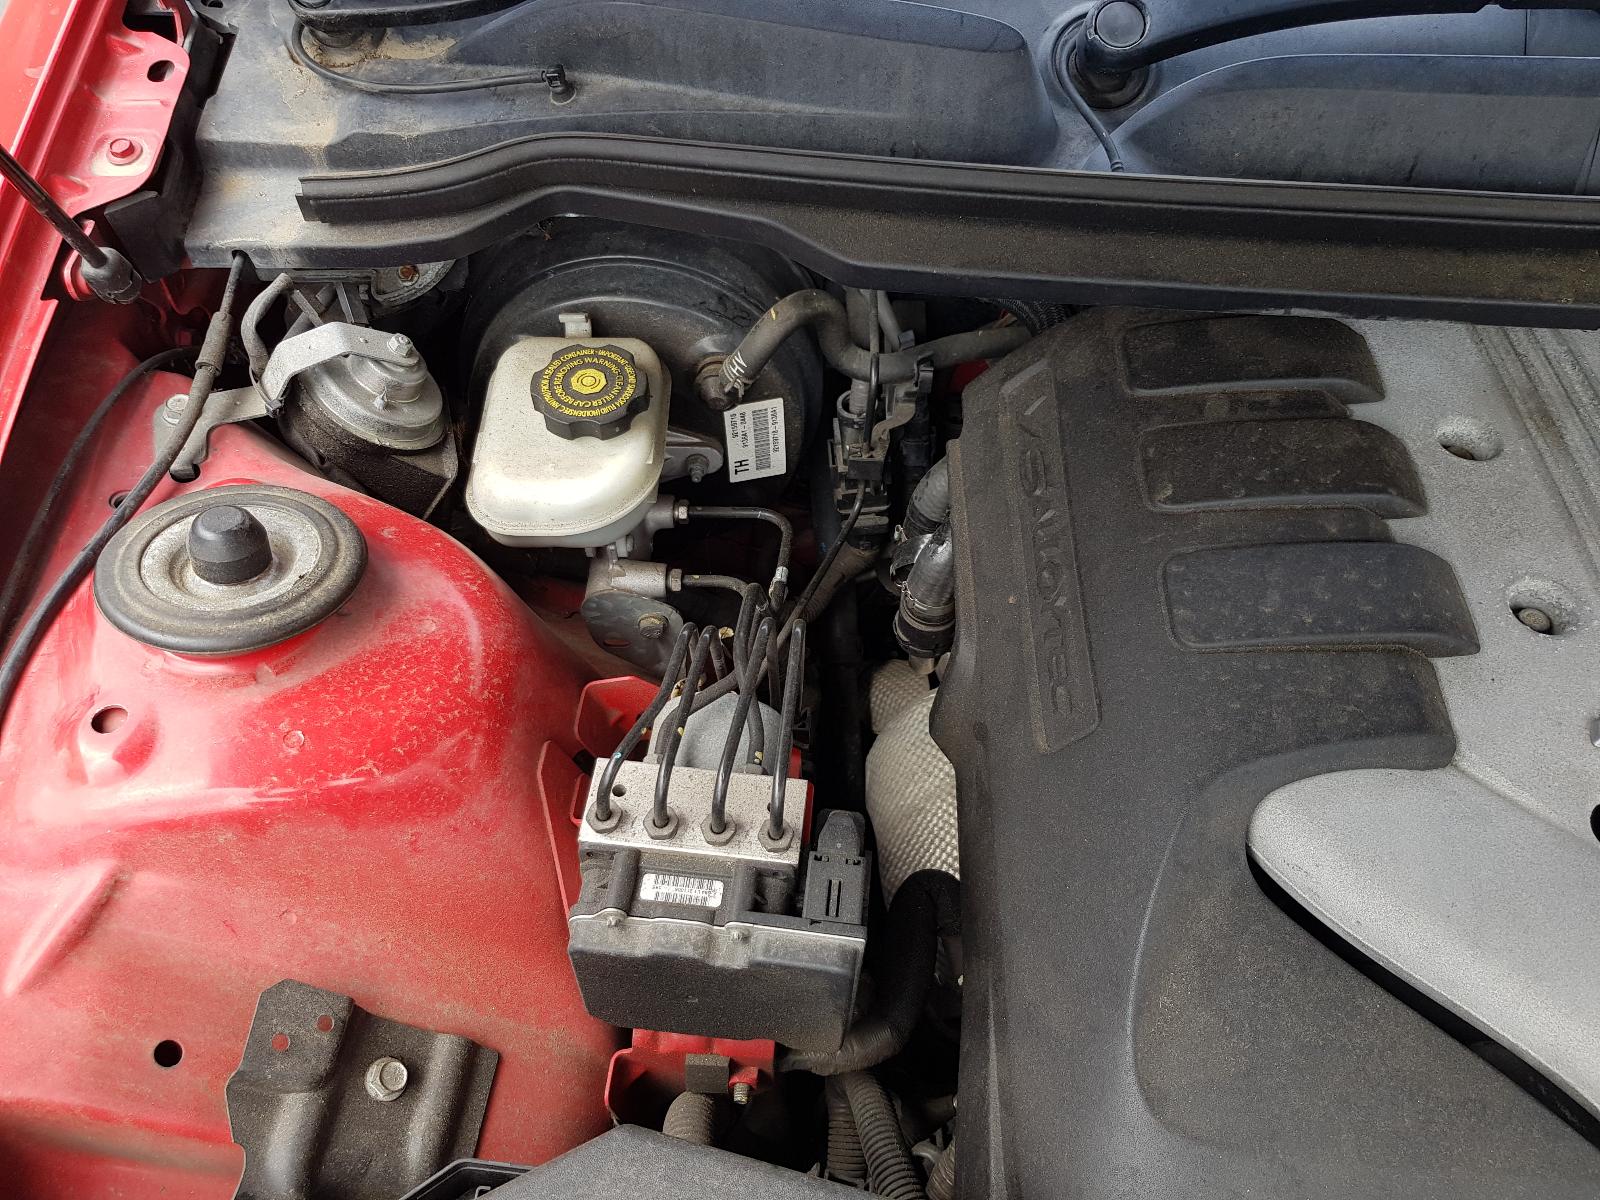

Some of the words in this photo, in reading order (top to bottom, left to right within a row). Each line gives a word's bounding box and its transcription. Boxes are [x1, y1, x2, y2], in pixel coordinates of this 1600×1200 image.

[560, 349, 595, 361] CONTAINER
[553, 359, 583, 385] REMOVING
[611, 374, 624, 396] CLEAN
[554, 384, 575, 405] BEFORE
[592, 394, 615, 407] FILLER
[573, 400, 592, 408] CAP
[734, 459, 749, 475] TH
